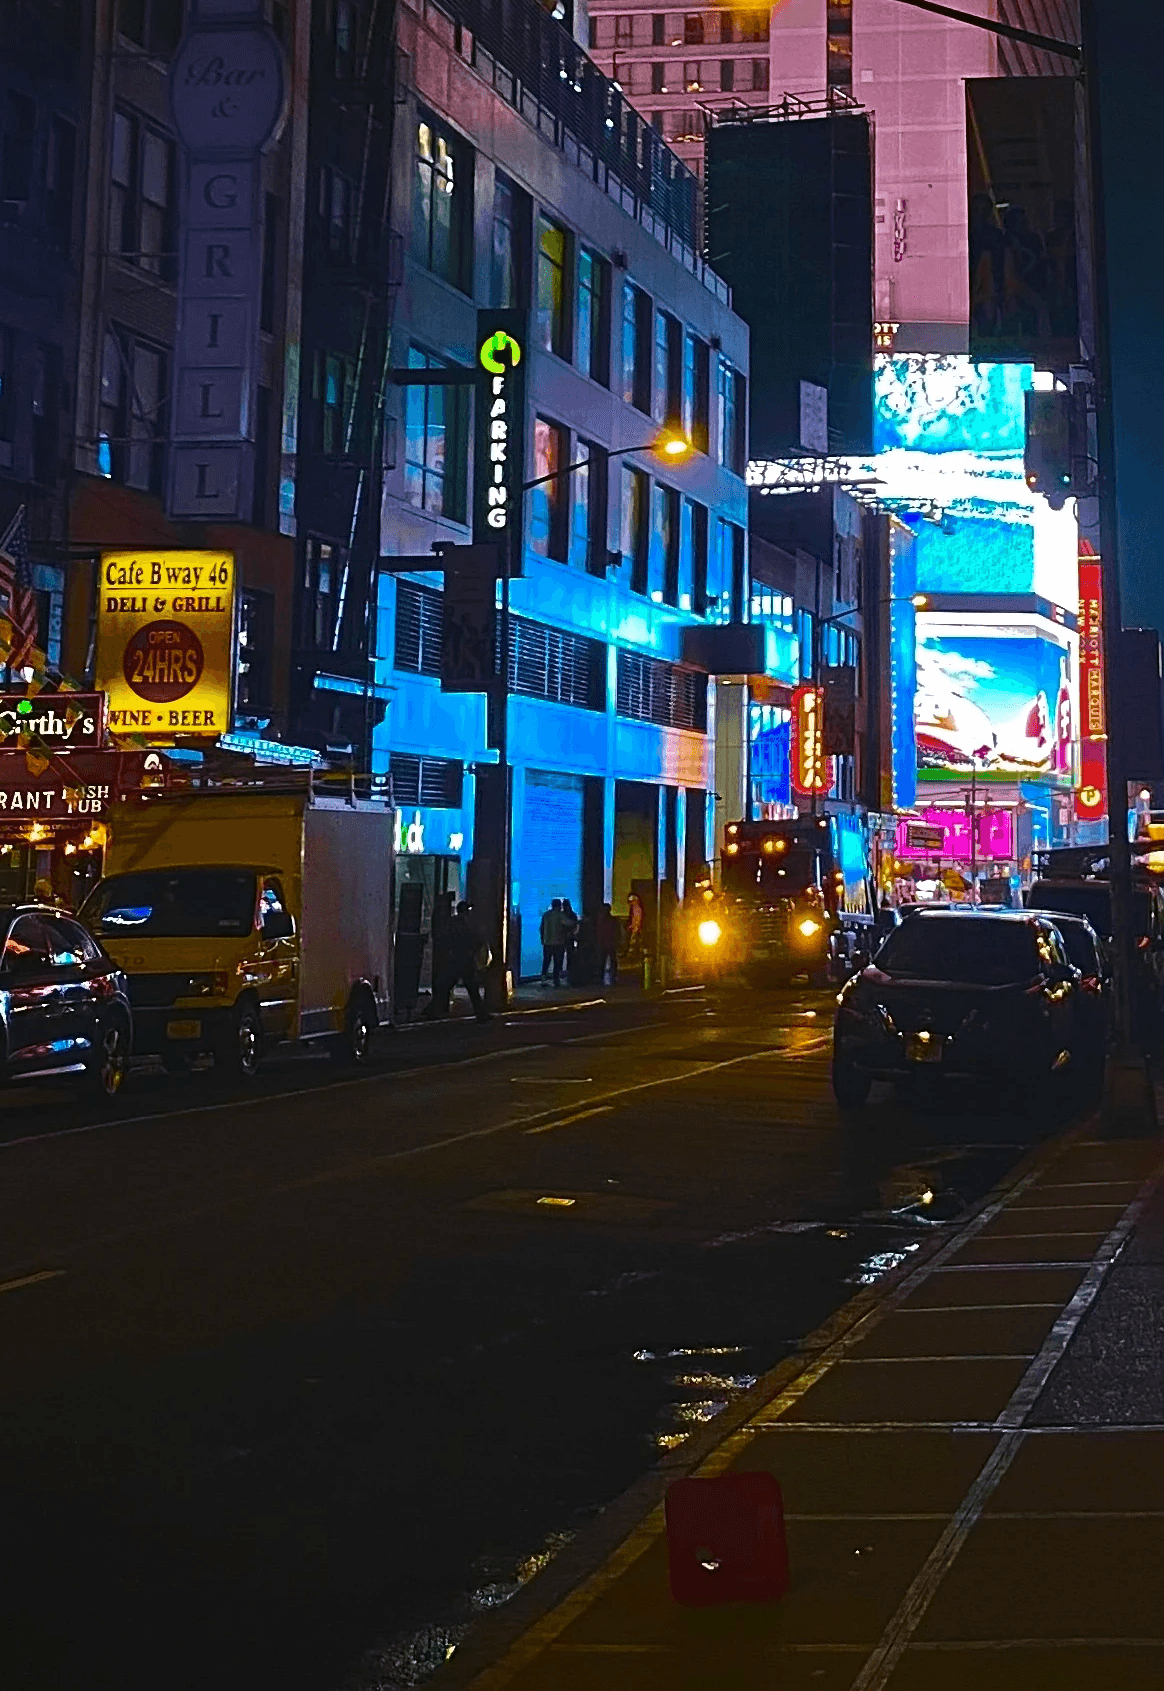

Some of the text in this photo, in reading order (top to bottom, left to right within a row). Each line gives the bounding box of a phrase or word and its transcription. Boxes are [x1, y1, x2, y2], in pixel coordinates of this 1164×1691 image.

[183, 56, 266, 87] Bar
[193, 173, 239, 499] GRILL
[487, 376, 508, 529] PARKING
[106, 560, 144, 586] Cafe
[208, 560, 229, 586] 46
[106, 596, 226, 613] DELI & GRILL
[131, 649, 198, 683] 24HRS
[108, 710, 216, 726] WINE BEER
